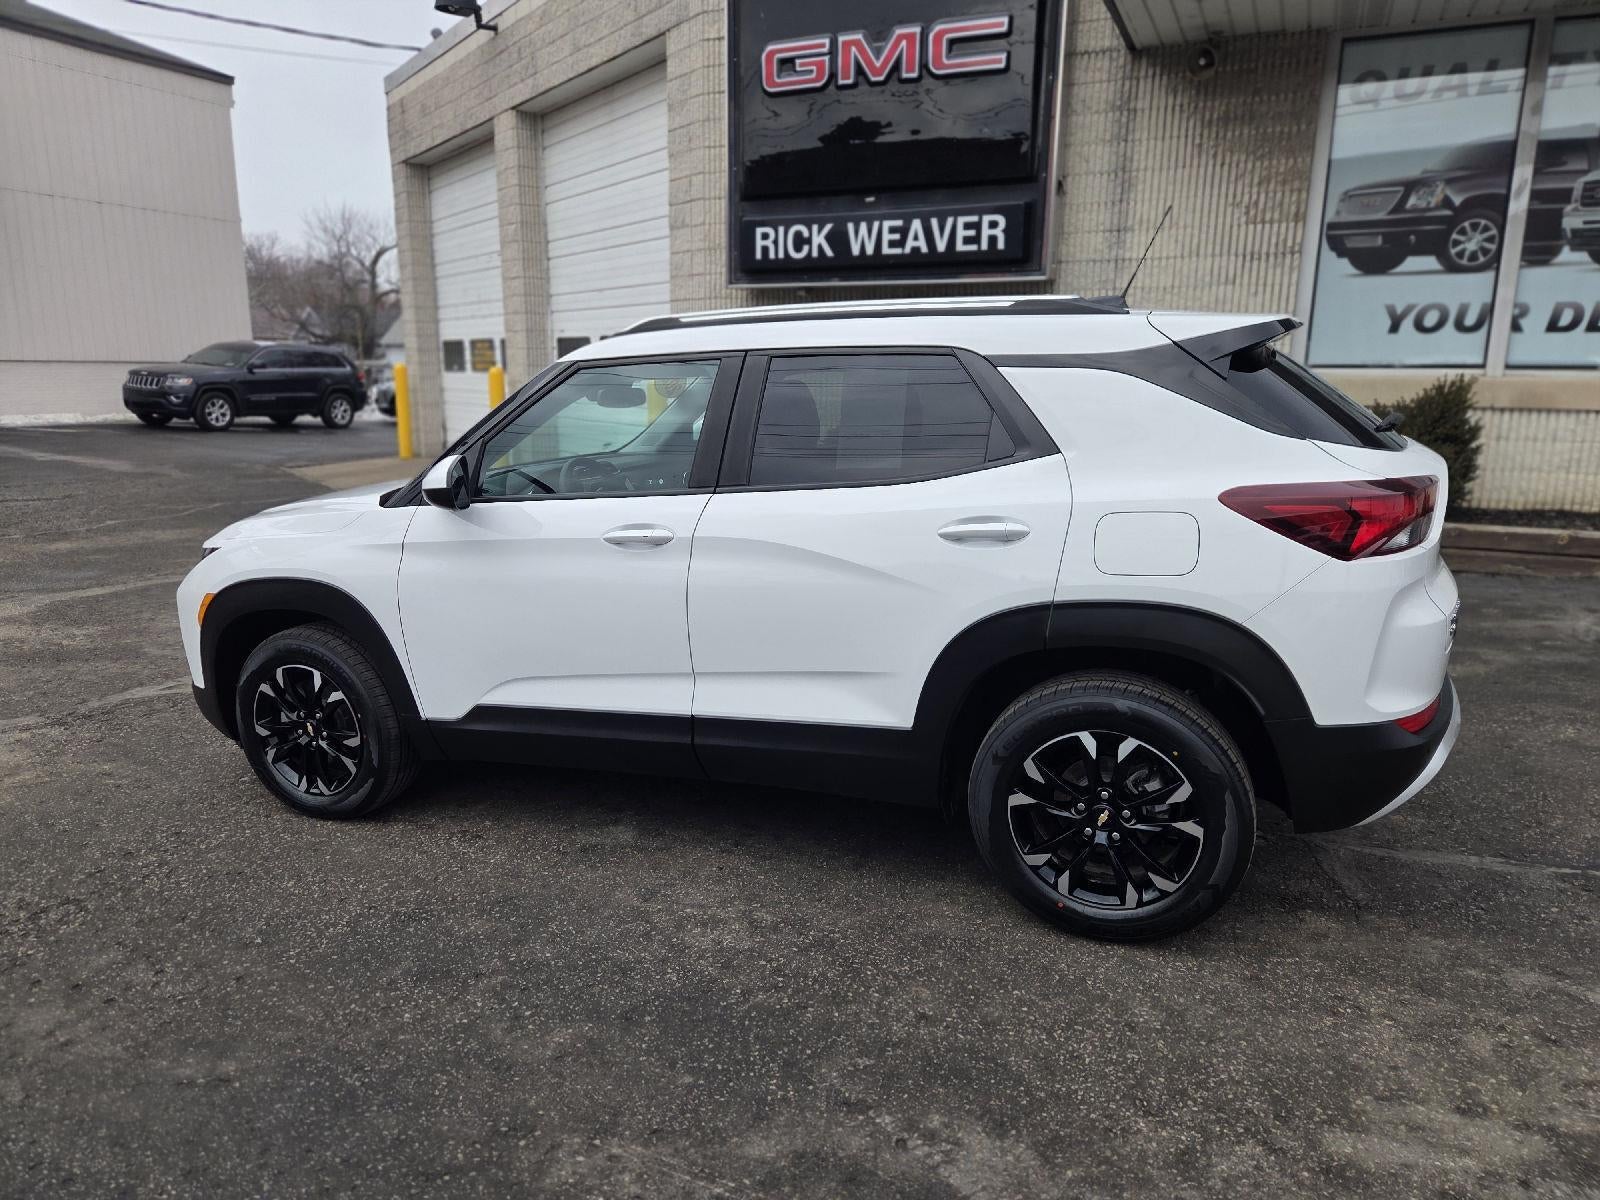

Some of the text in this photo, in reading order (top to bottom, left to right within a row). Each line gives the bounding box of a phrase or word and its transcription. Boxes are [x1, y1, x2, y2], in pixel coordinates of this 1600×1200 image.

[761, 15, 1010, 93] GMC
[1350, 48, 1600, 107] QUALT
[754, 214, 1007, 260] RICK WEAVER
[1384, 301, 1531, 334] YOUR
